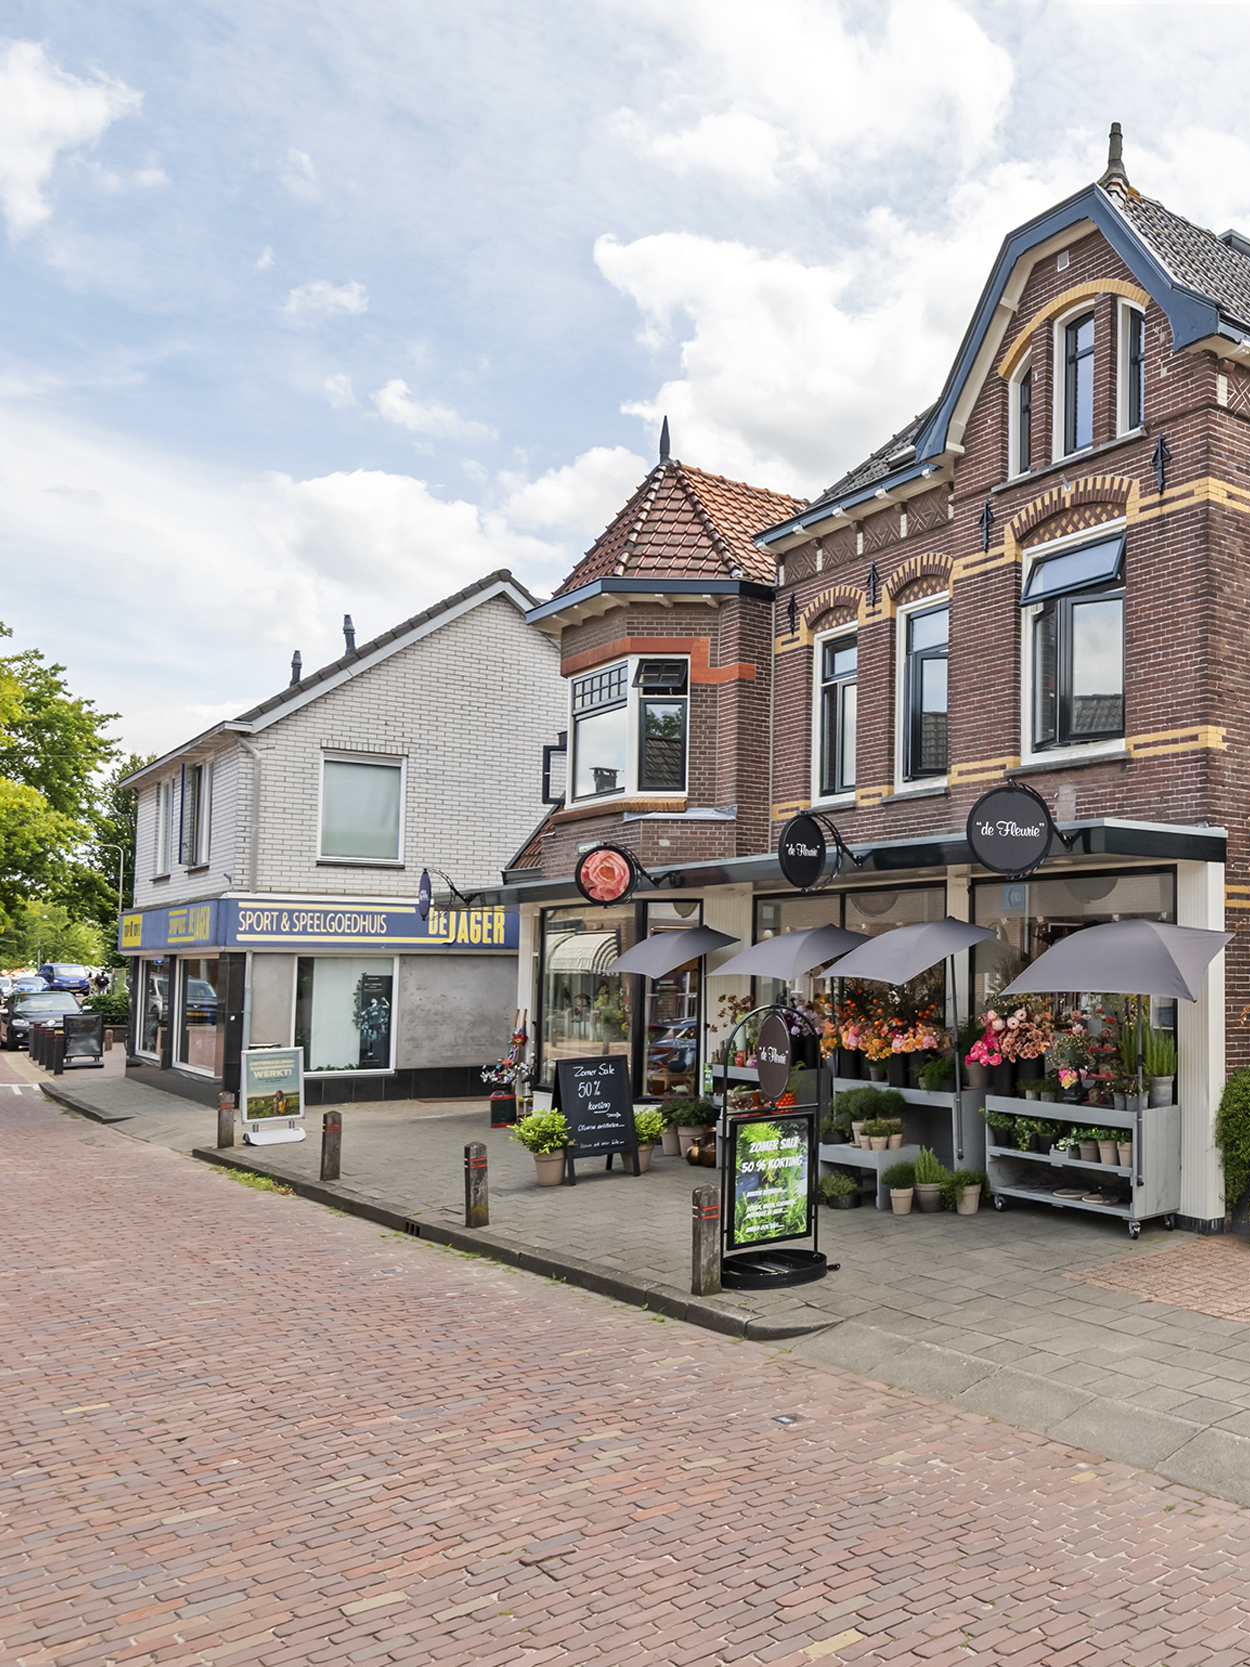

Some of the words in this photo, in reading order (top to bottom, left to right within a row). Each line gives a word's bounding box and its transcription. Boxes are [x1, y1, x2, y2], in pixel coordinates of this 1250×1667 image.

[238, 911, 278, 932] SPORT
[281, 912, 290, 932] &
[292, 912, 387, 934] SPEELGOEDHUIS
[253, 1069, 292, 1078] WERKT!
[573, 1066, 597, 1078] Zomer
[598, 1063, 615, 1076] Sale
[749, 1138, 779, 1153] ZOMER
[780, 1136, 801, 1149] SALE
[741, 1161, 754, 1173] 50
[767, 1155, 803, 1170] KORTING
